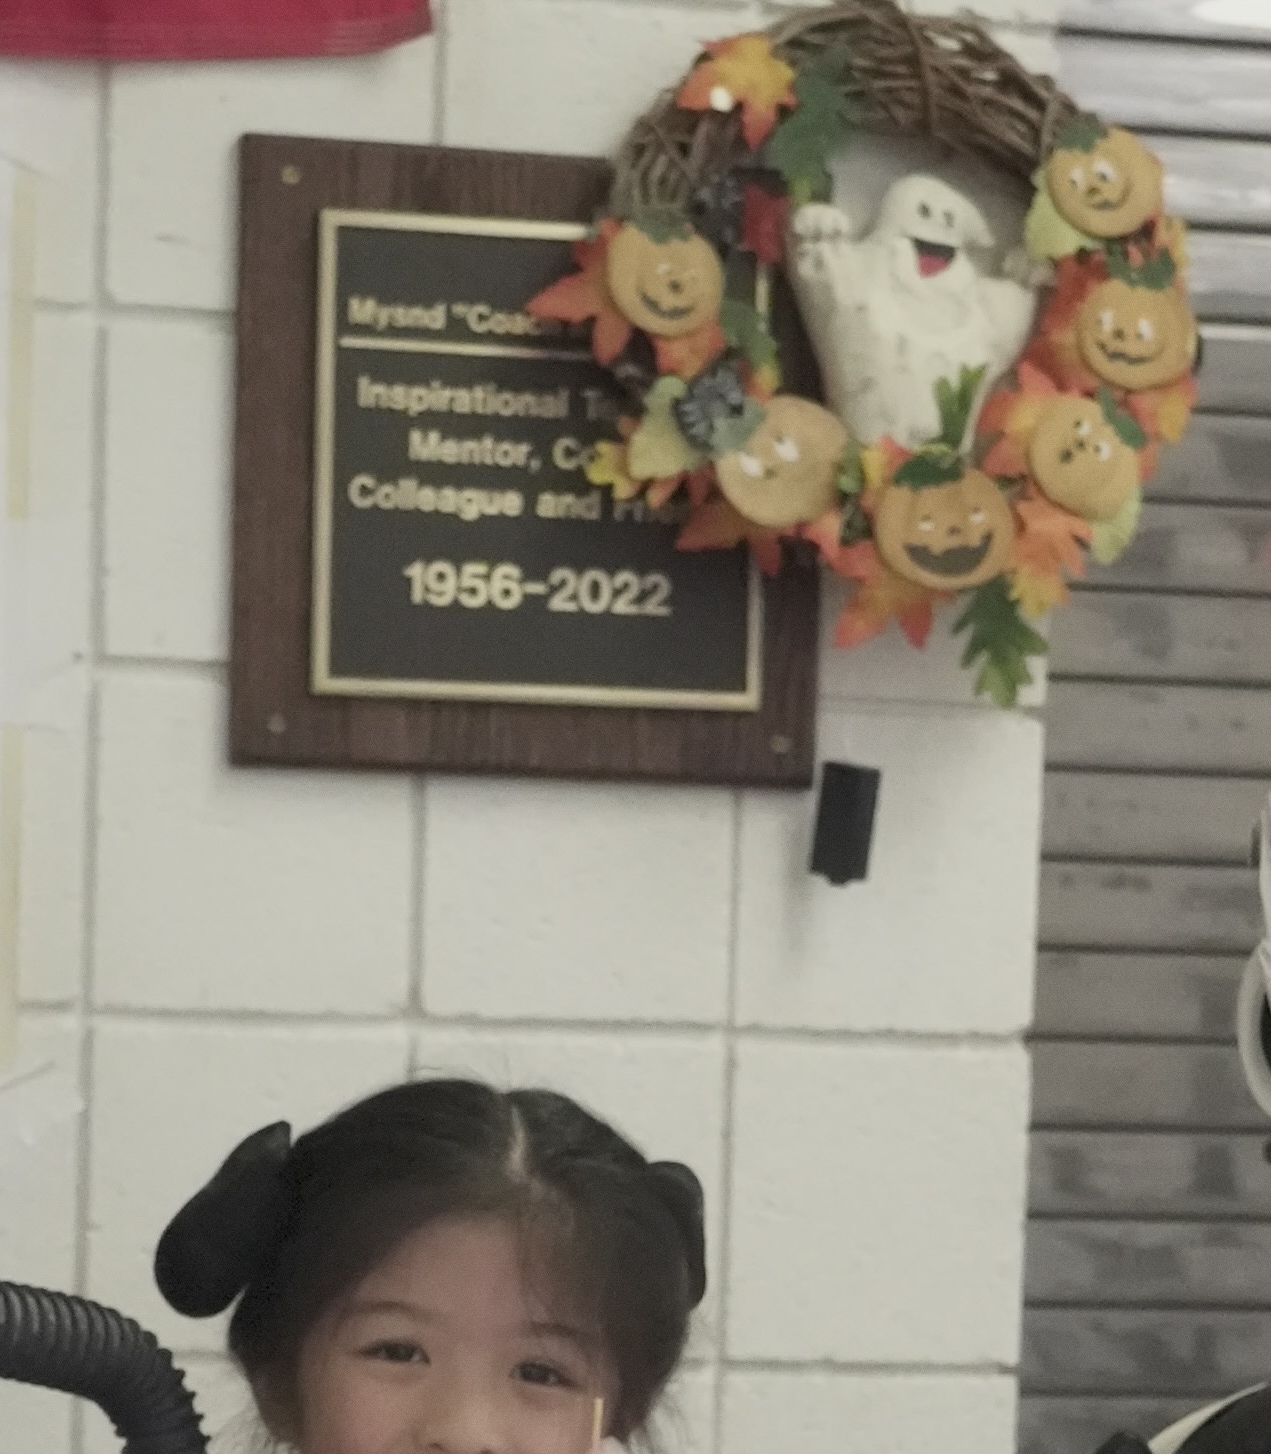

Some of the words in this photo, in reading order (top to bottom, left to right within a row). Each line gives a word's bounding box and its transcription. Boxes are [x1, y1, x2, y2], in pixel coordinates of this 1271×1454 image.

[356, 374, 570, 419] Inspirational
[408, 429, 541, 474] Mentor,
[346, 473, 525, 522] Colleague
[534, 488, 602, 521] and
[403, 558, 673, 618] 1956-2022
